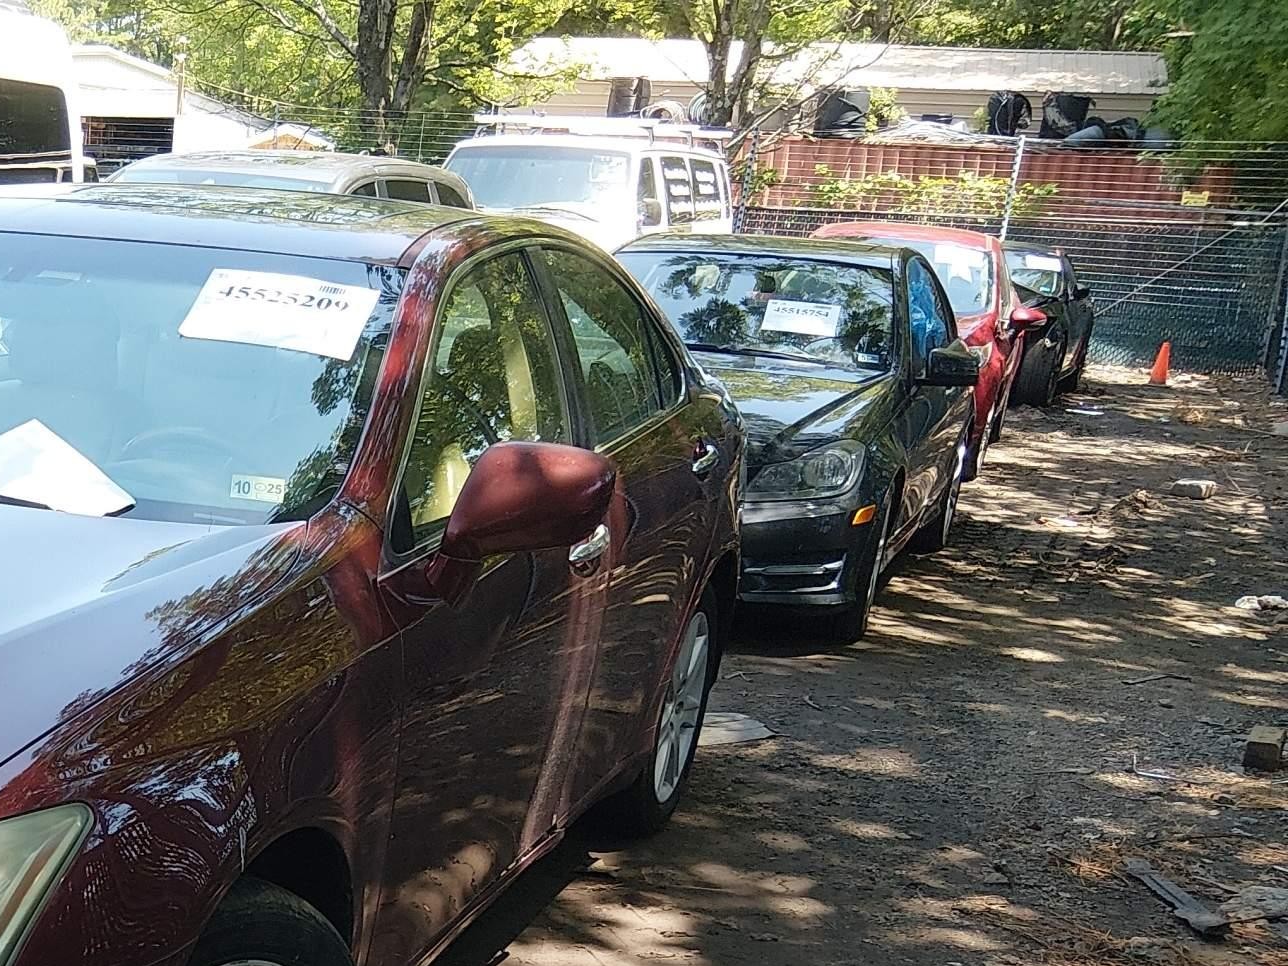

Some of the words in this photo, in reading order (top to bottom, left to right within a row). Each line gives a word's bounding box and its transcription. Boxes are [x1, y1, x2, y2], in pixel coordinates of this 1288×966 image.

[218, 286, 350, 312] 45525209
[234, 480, 252, 495] 10
[267, 483, 283, 495] 25
